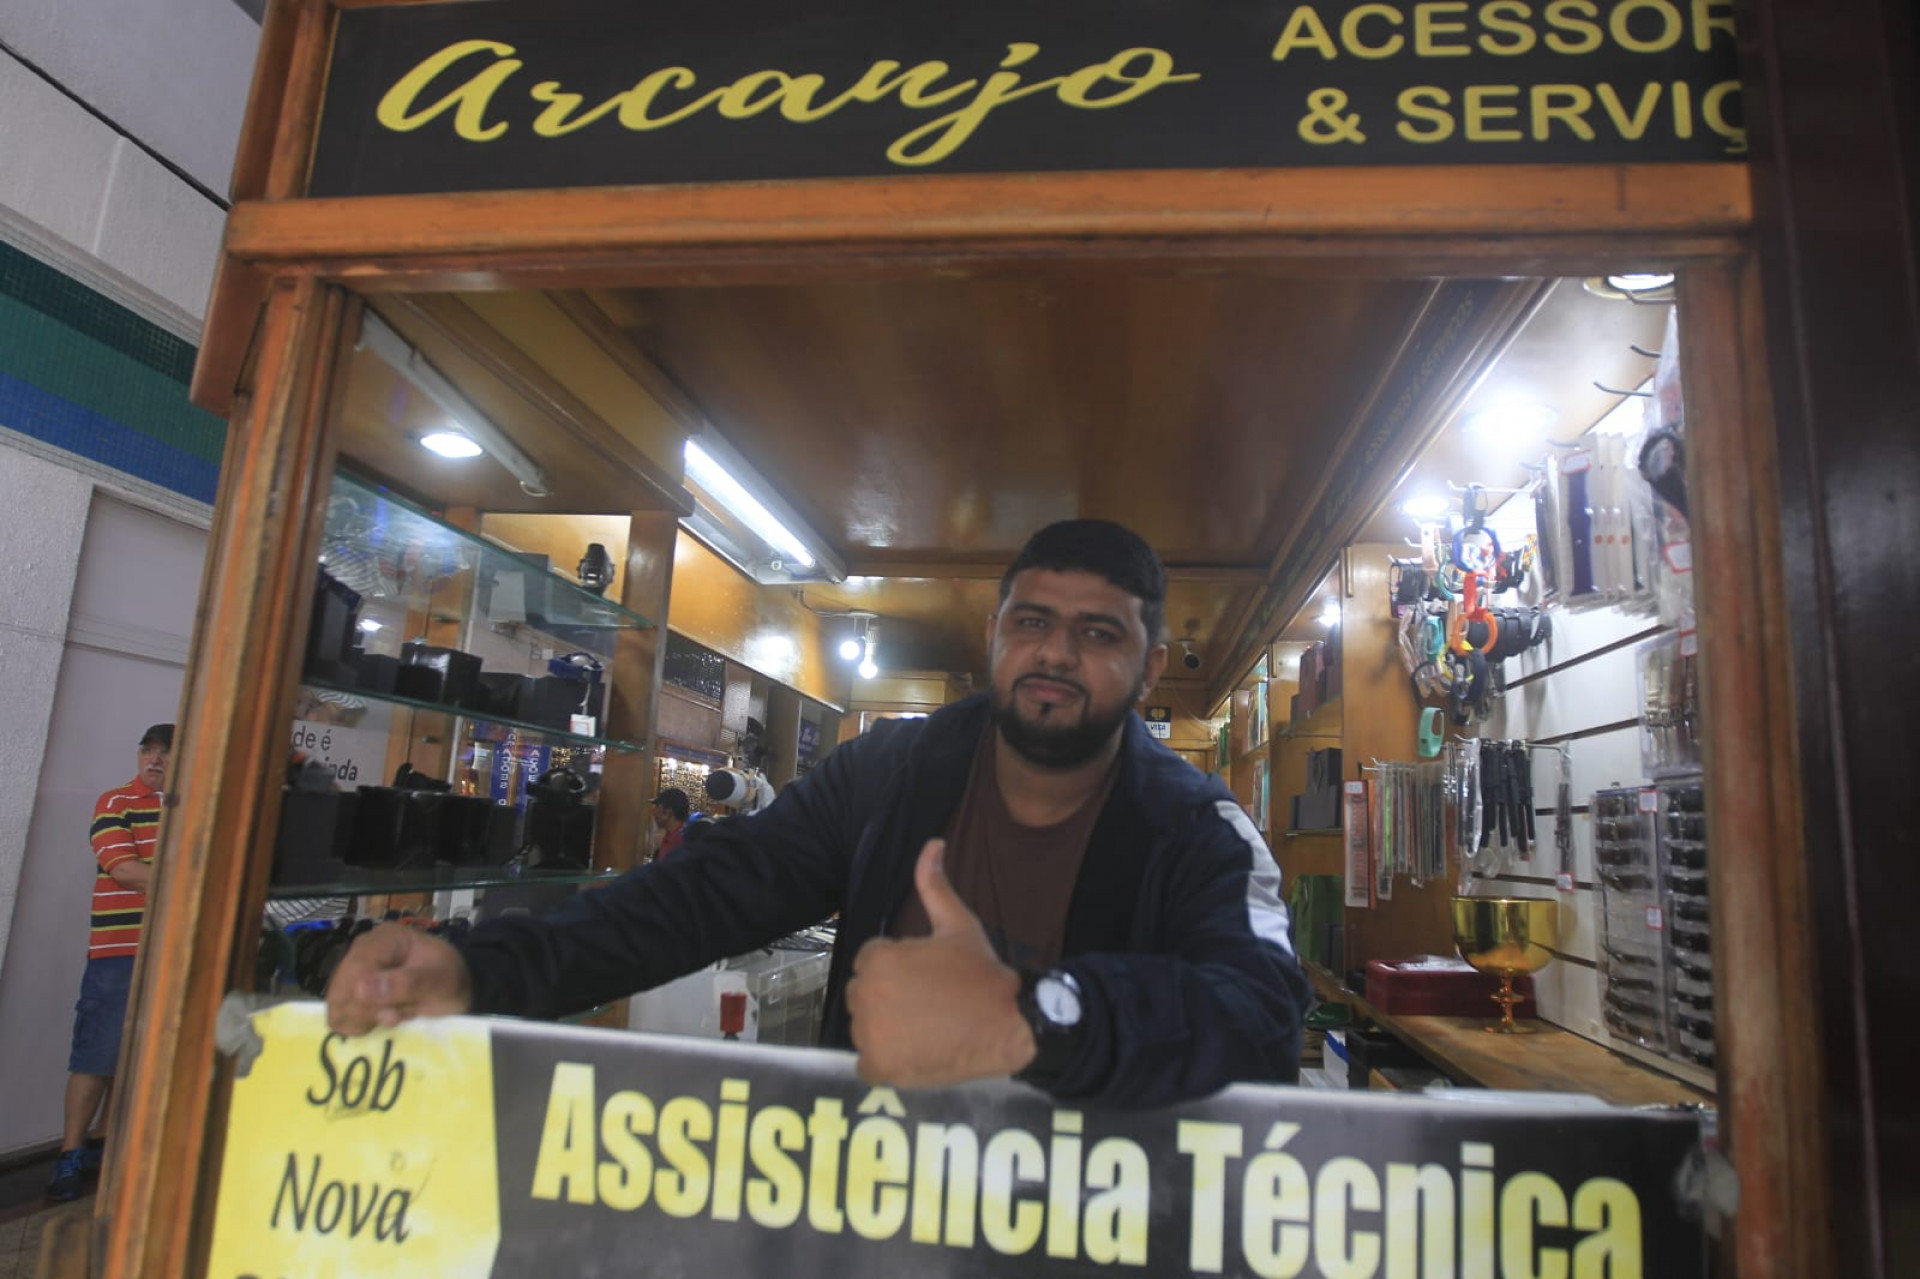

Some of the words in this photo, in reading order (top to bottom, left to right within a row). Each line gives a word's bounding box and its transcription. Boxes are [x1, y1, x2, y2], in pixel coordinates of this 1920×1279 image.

[376, 39, 1201, 167] Arcanjo
[1297, 87, 1366, 145] &
[320, 729, 332, 751] é
[306, 1031, 406, 1112] Sob
[270, 1152, 416, 1244] Nova
[530, 1061, 1149, 1267] Assistência
[1176, 1119, 1644, 1279] Técnica
